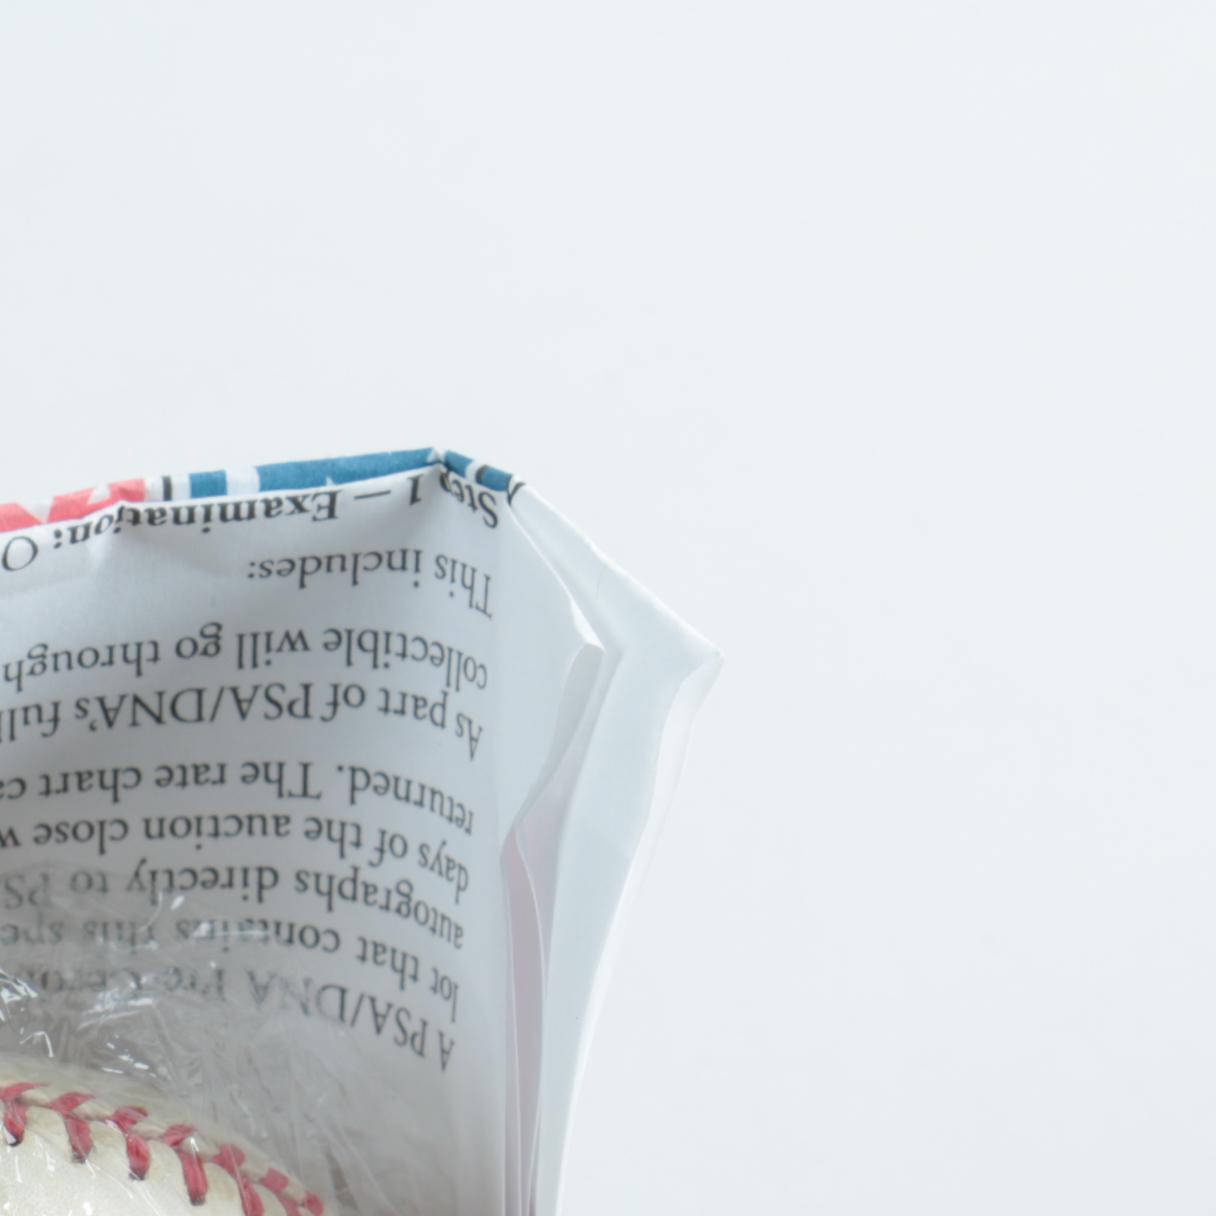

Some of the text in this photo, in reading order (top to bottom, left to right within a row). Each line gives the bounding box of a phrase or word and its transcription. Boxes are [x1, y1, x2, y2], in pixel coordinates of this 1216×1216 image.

[405, 473, 424, 507] 1
[52, 489, 342, 550] Examination:
[246, 547, 495, 622] This includes:
[173, 621, 225, 661] go
[236, 629, 311, 671] will
[321, 628, 489, 694] collectible
[1, 638, 161, 694] through
[317, 682, 367, 724] of
[375, 687, 450, 731] part
[454, 711, 484, 762] As
[37, 766, 143, 805] chart
[153, 761, 228, 792] rate
[239, 760, 322, 801] The
[335, 764, 475, 836] returned.
[32, 818, 130, 856] close
[141, 813, 292, 851] auction
[302, 816, 363, 860] the
[367, 829, 409, 868] of
[69, 870, 110, 898] to
[126, 857, 280, 907] directly
[417, 839, 470, 906] days
[294, 865, 465, 950] autographs
[174, 918, 342, 954] contains
[356, 935, 420, 992] that
[430, 966, 459, 1024] lot
[437, 1030, 455, 1074] A
